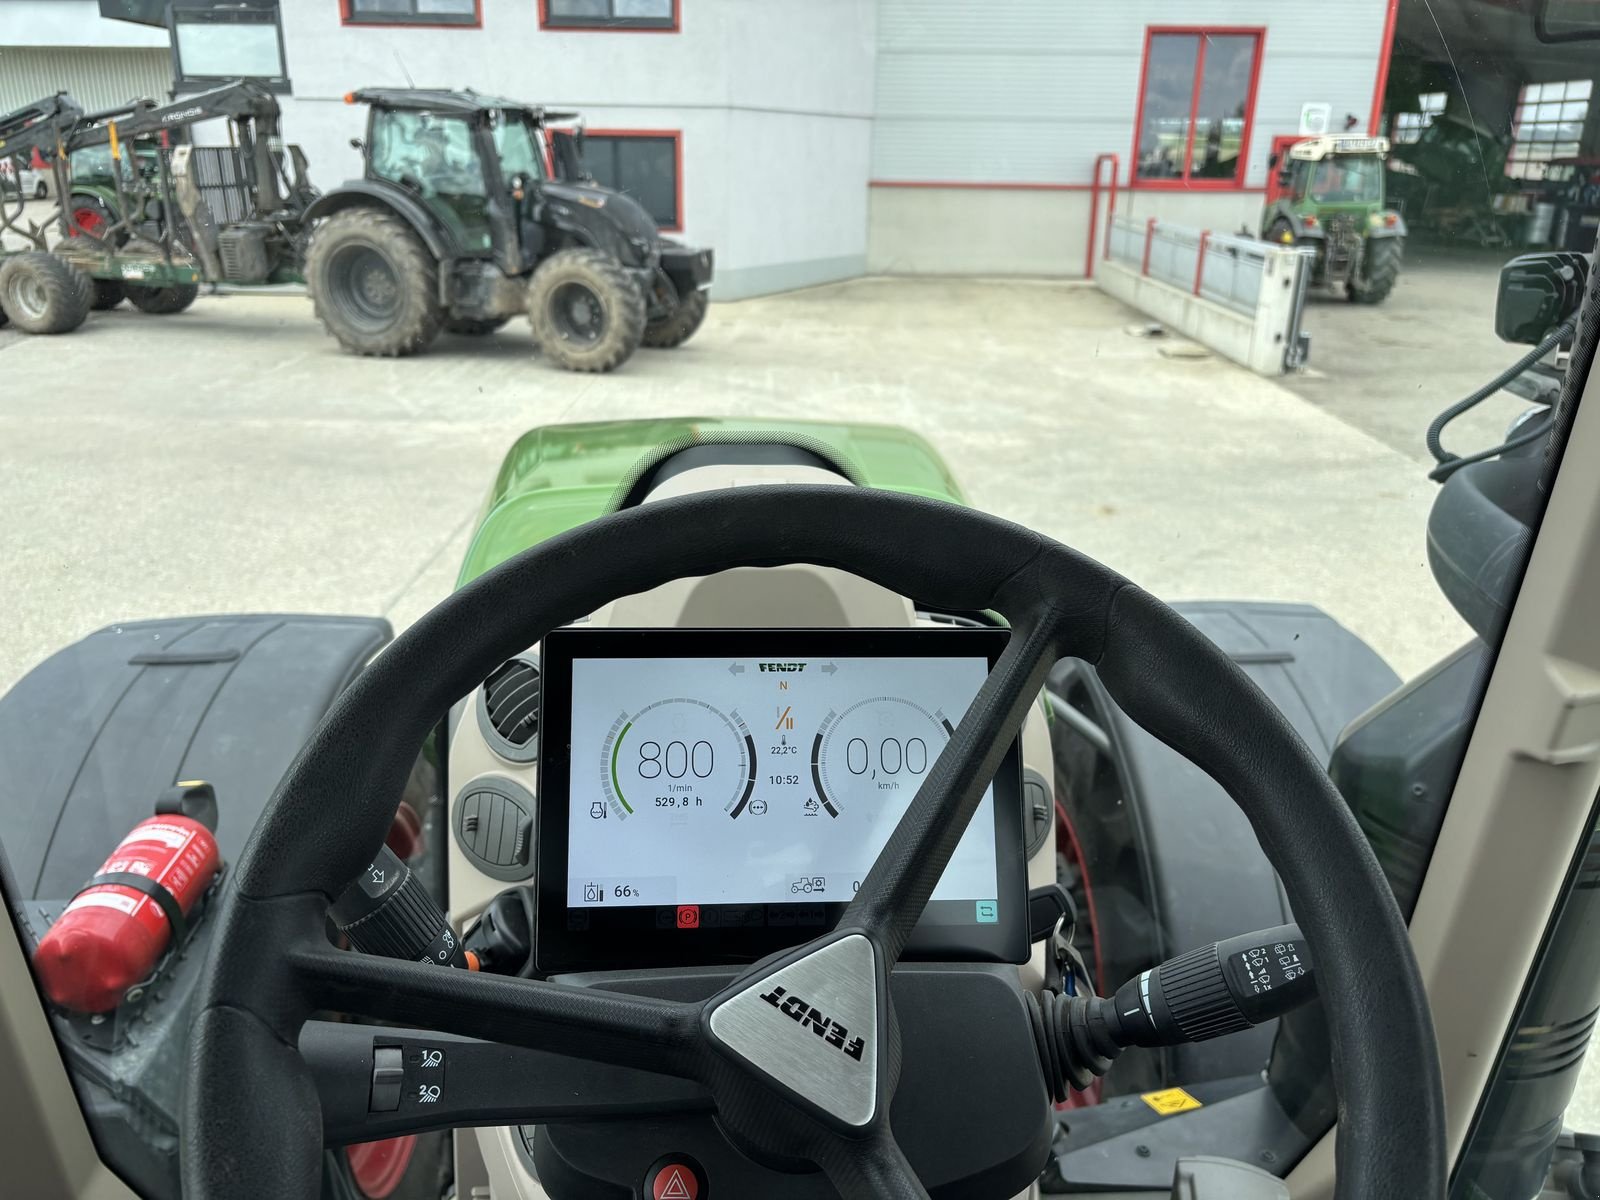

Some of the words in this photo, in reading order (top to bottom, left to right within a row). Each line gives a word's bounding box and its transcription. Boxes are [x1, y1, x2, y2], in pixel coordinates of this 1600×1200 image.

[759, 663, 807, 672] FENDT
[780, 681, 788, 690] N
[771, 746, 798, 755] 22,2°C
[638, 740, 714, 779] 800
[846, 737, 928, 780] 0,00
[769, 775, 799, 785] 10:52
[668, 784, 693, 793] 1/min
[878, 782, 900, 790] km/h
[655, 797, 689, 808] 529,8
[695, 796, 703, 807] h
[759, 986, 865, 1062] FENDT
[421, 1050, 428, 1060] 1
[419, 1085, 427, 1095] 2
